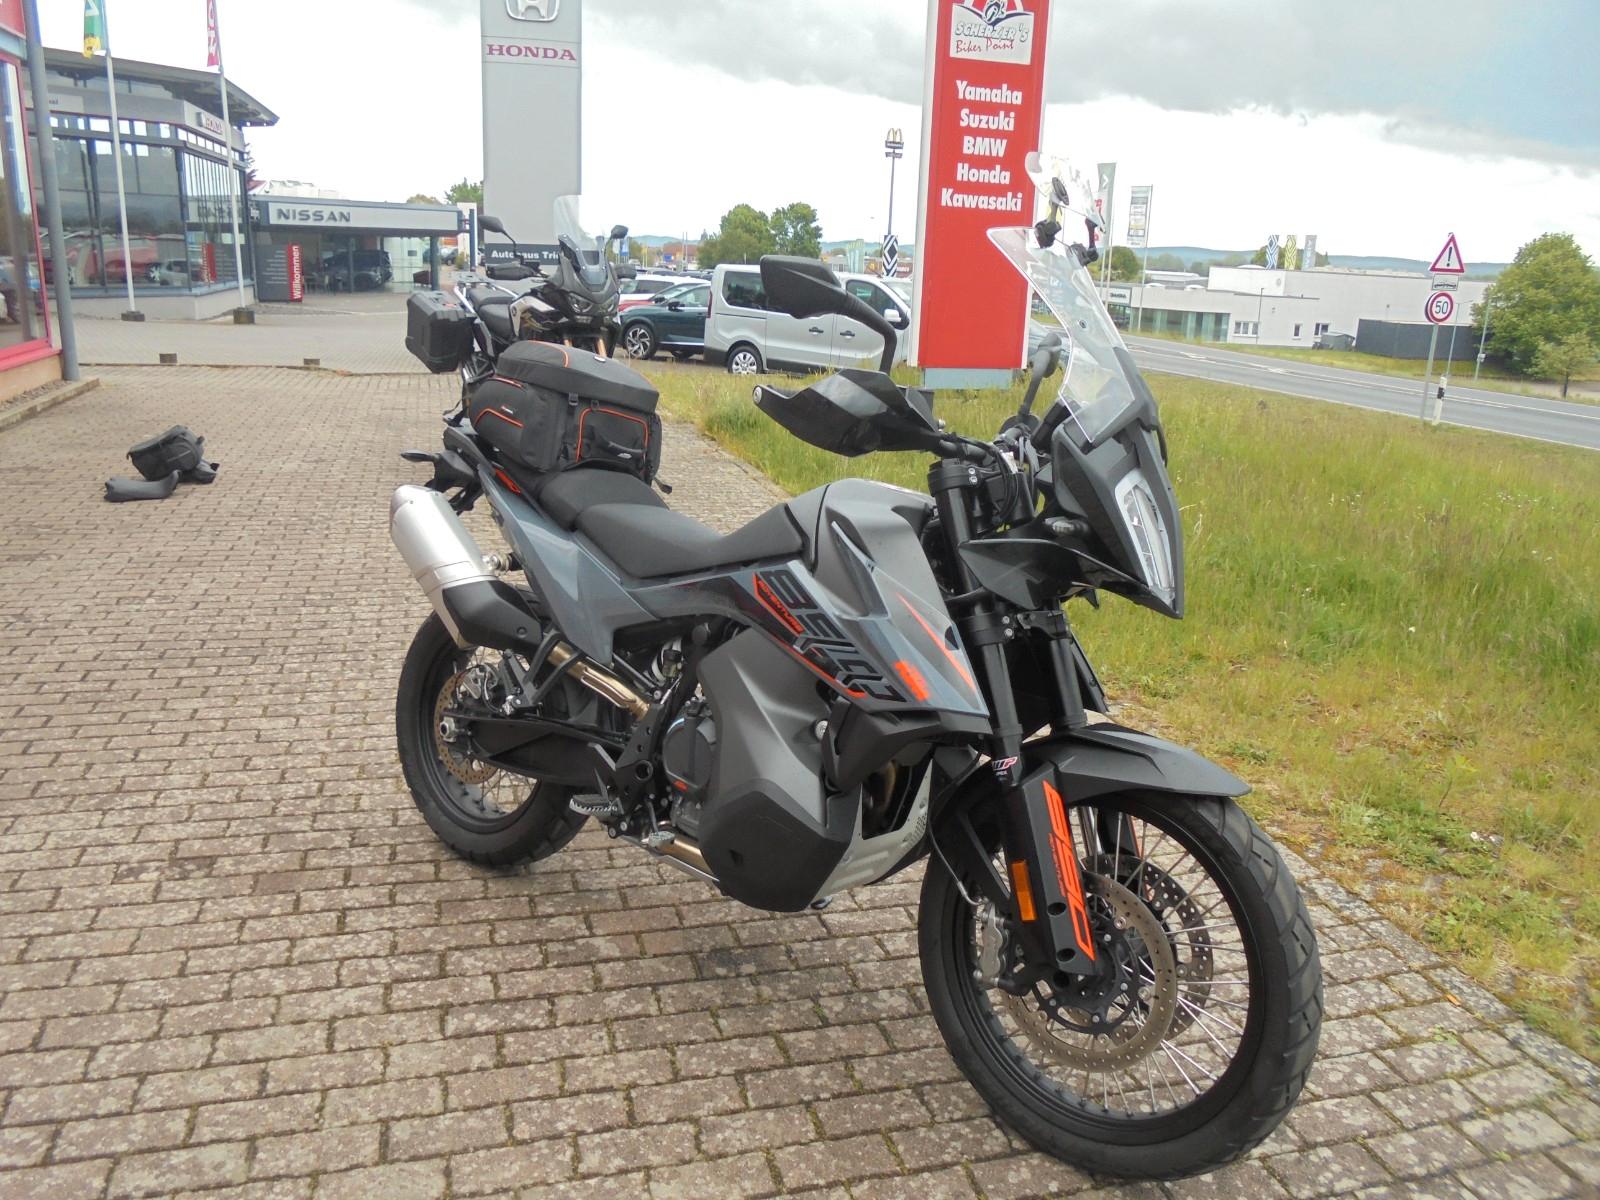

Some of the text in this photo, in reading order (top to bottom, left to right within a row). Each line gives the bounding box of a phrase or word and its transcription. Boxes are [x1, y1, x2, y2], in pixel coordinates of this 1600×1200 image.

[487, 44, 577, 61] HONDA
[956, 36, 1014, 53] Biker Point
[956, 80, 1022, 105] Yamaha
[960, 108, 1015, 131] Suzuki
[963, 135, 1007, 158] BMW
[956, 162, 1011, 185] Honda
[941, 187, 1023, 212] Kawasaki
[277, 208, 351, 223] NISSAN
[491, 250, 540, 260] Autoaus
[292, 245, 302, 299] Willkommen
[1434, 300, 1449, 315] 50
